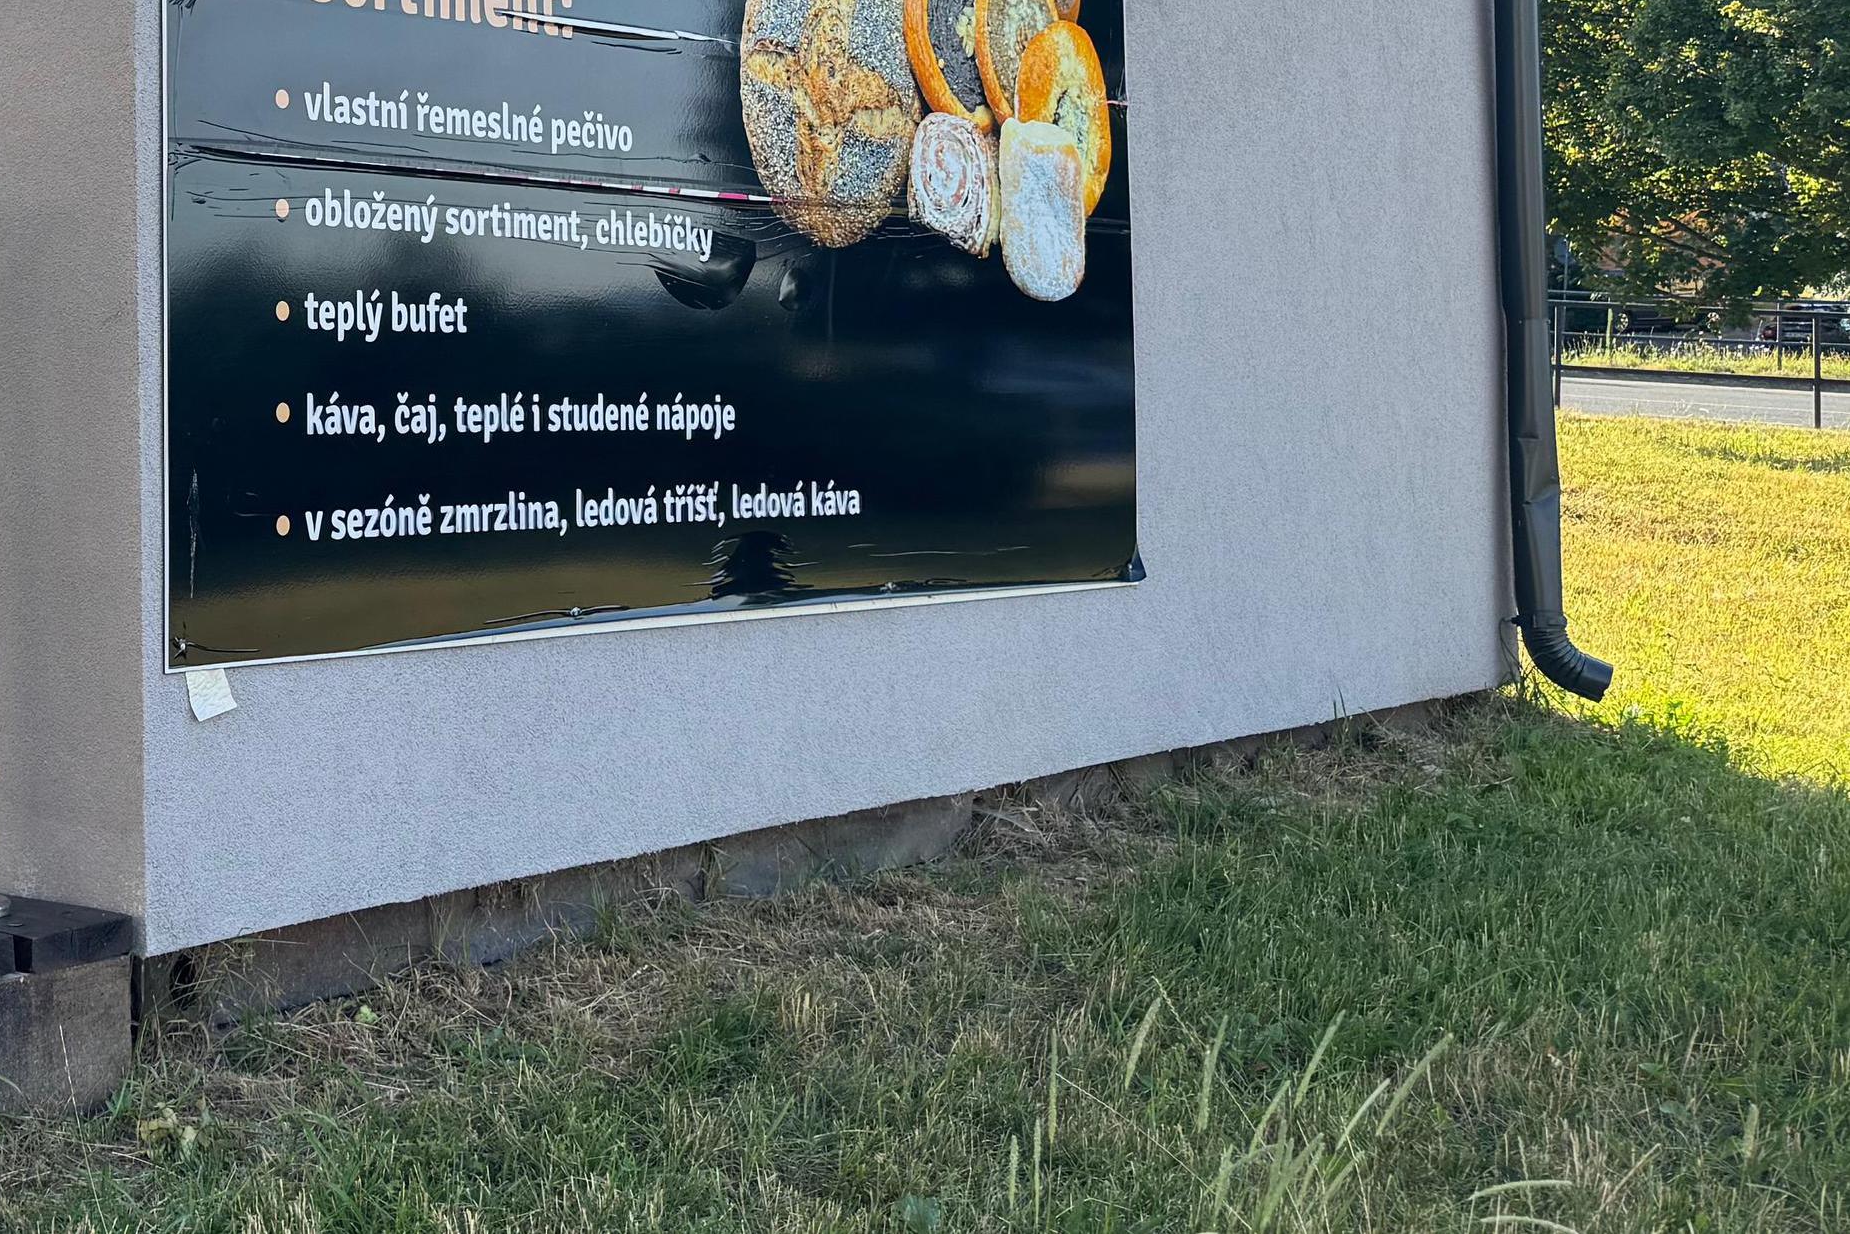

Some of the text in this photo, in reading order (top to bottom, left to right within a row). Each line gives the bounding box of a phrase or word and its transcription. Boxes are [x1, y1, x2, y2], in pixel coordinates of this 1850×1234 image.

[304, 82, 633, 154] vlastní řemeslné pečivo
[305, 190, 713, 262] obložený sortiment, chlebíčky
[305, 293, 467, 341] teplý bufet
[306, 393, 736, 442] káva, čaj, teplé i studené nápoje
[305, 480, 860, 540] v sezóně zmrzlina, ledová tříšť, ledová káva
